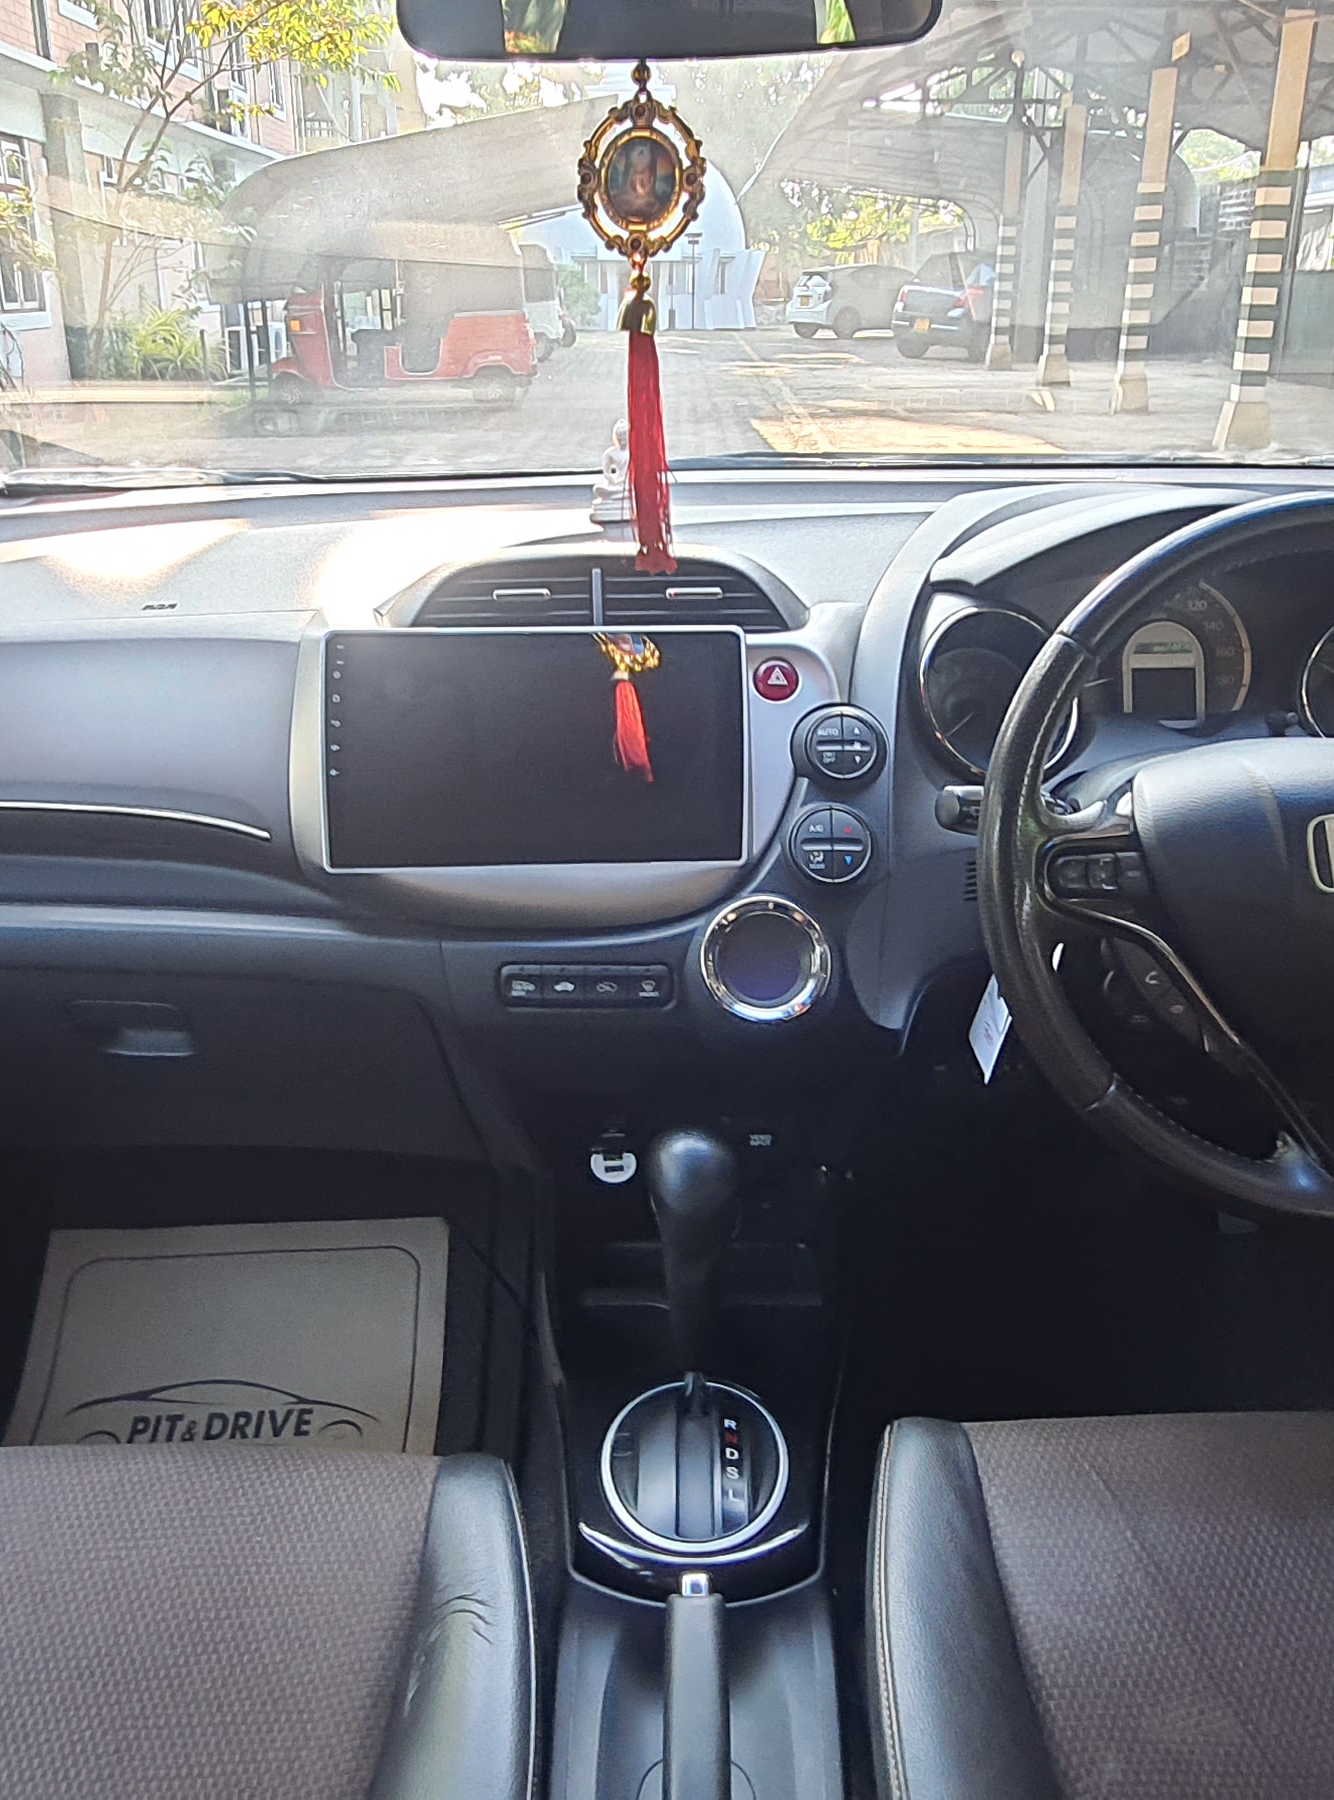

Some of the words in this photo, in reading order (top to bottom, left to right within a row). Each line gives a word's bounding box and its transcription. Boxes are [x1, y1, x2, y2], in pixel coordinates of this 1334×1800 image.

[817, 727, 840, 737] AUTO
[725, 1447, 740, 1460] D
[726, 1466, 740, 1480] S
